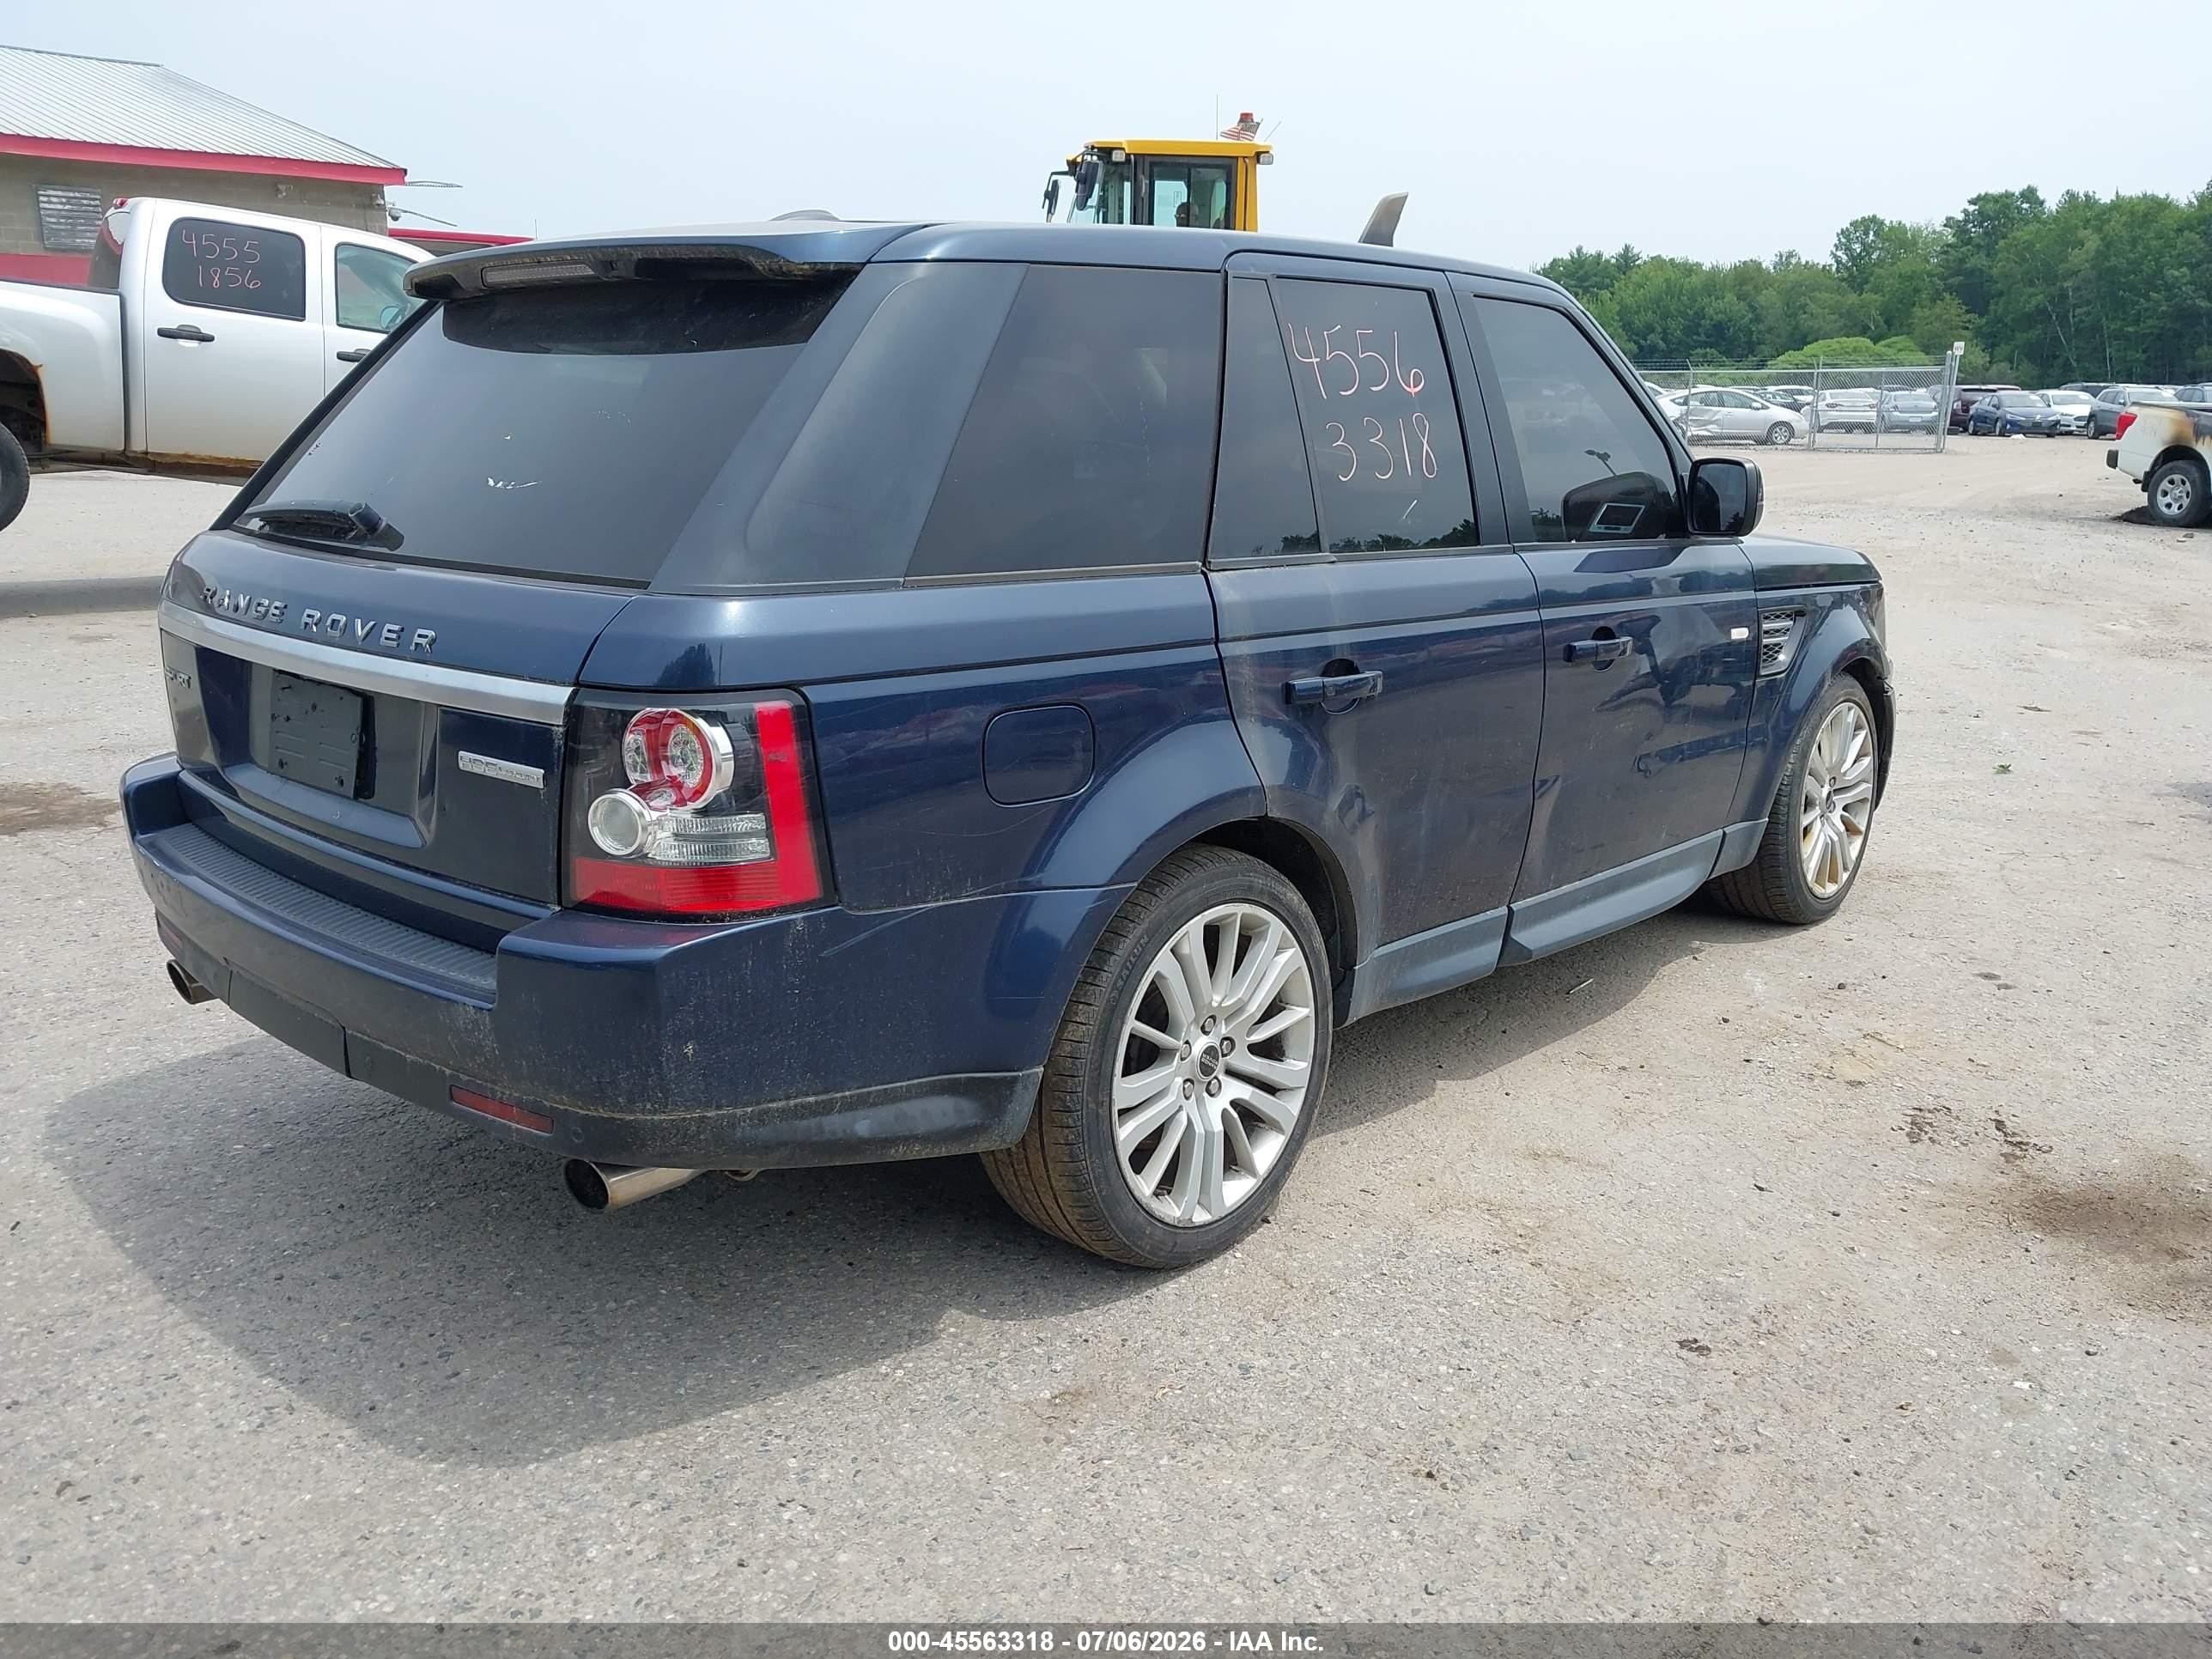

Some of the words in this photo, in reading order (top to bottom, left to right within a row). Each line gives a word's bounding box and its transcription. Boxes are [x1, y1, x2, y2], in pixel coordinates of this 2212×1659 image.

[181, 228, 261, 264] 4555
[198, 264, 262, 289] 1856
[1288, 322, 1425, 400] 4556
[1325, 412, 1437, 482] 3318
[201, 586, 289, 623] RANGE
[302, 608, 436, 653] ROVER
